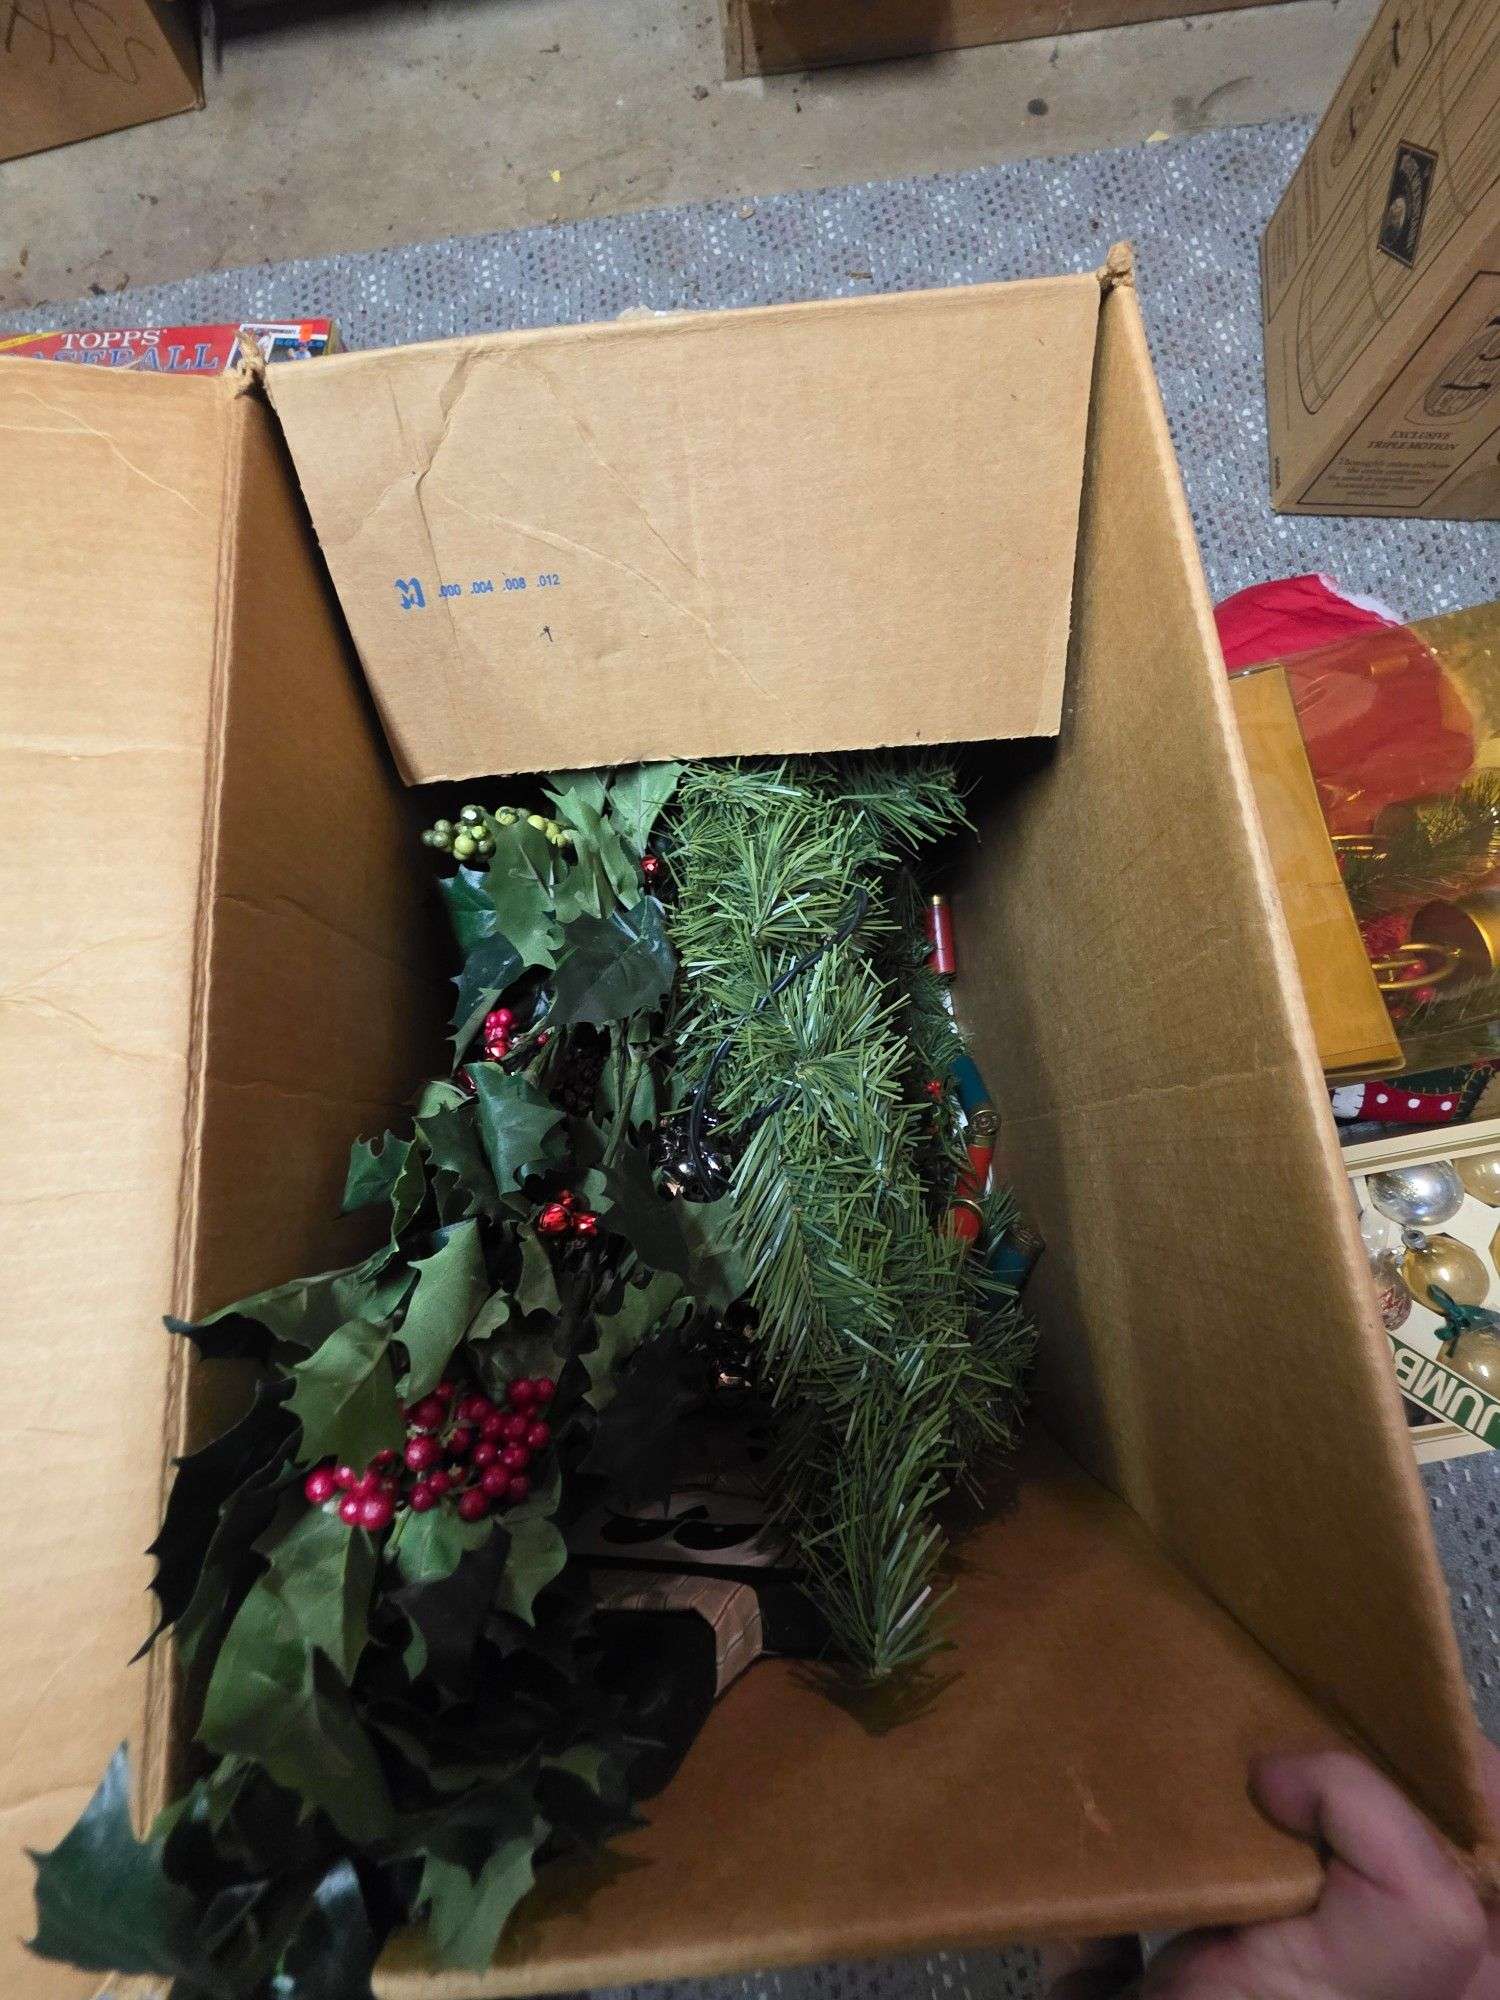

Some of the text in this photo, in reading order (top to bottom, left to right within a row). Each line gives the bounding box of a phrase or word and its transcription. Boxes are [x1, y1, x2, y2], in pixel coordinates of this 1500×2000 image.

[61, 329, 161, 349] TOPPS
[470, 579, 494, 594] .004
[502, 576, 527, 591] .008
[536, 573, 561, 588] .012
[1386, 1335, 1500, 1438] JUMB
